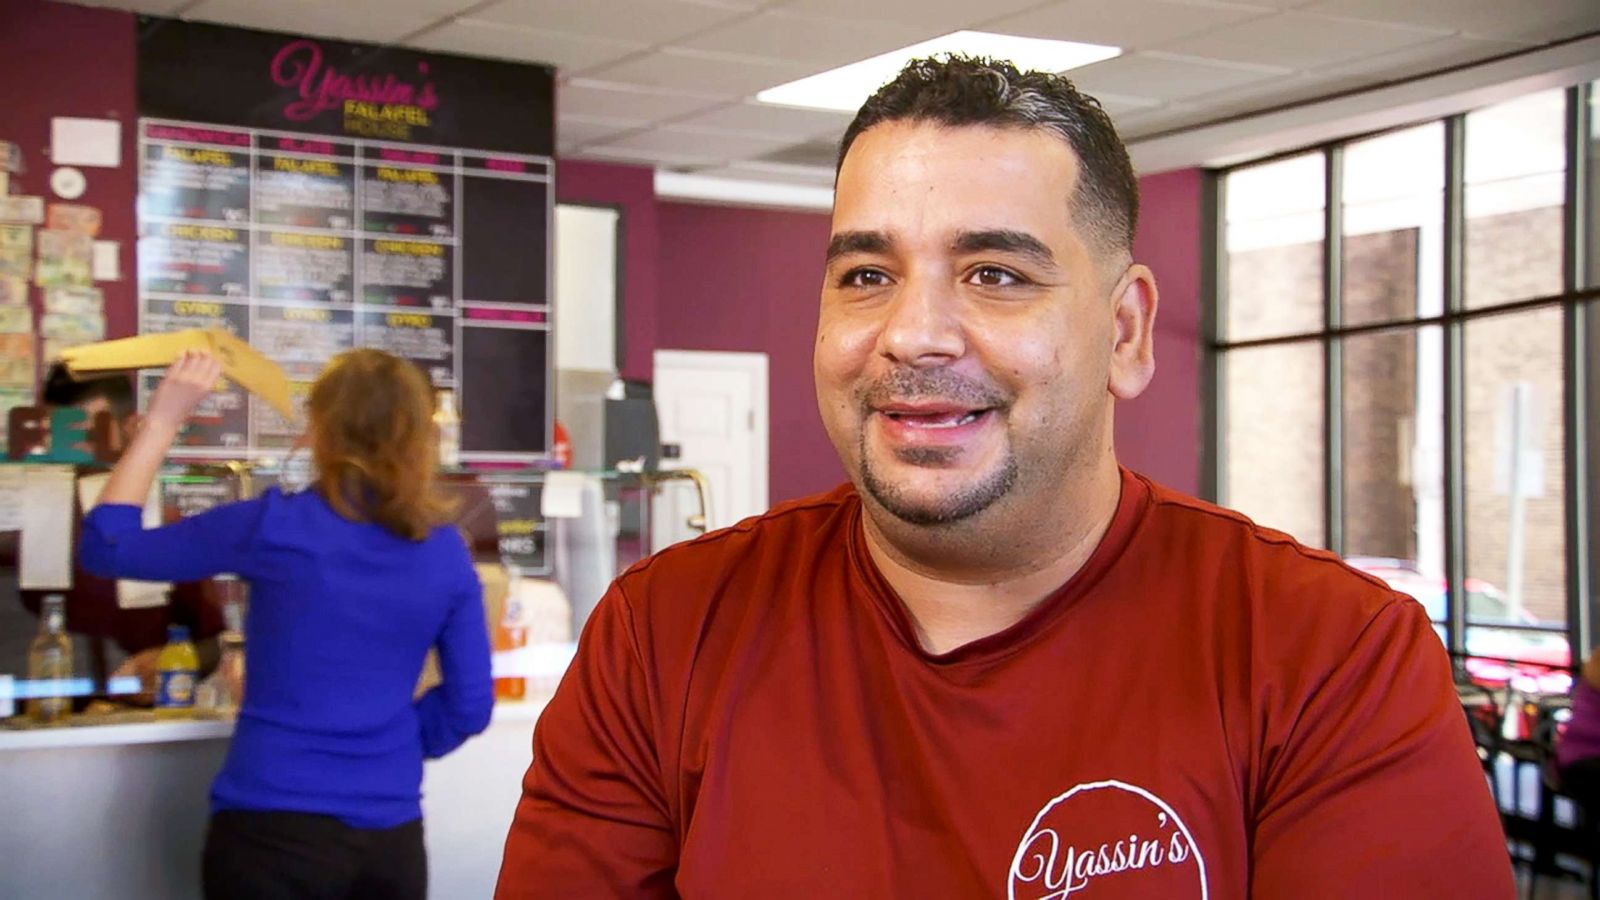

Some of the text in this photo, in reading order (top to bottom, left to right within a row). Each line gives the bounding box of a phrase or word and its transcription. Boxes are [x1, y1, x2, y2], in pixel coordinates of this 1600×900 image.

[270, 39, 438, 121] Yassin's
[344, 99, 431, 127] FALAFEL
[1015, 811, 1190, 900] Yassin's
